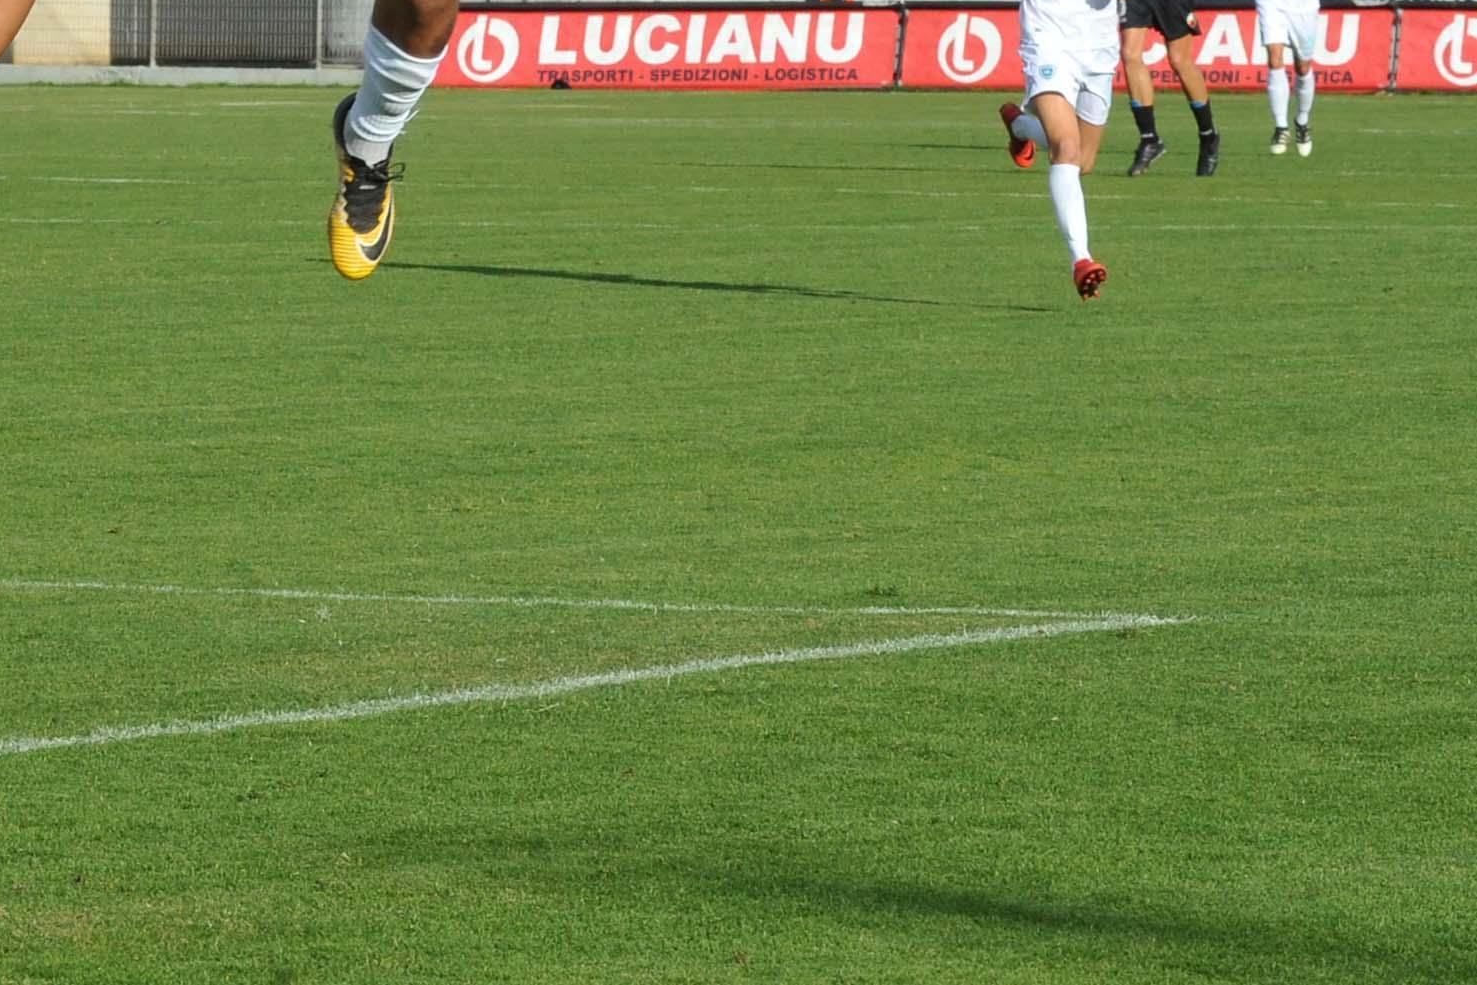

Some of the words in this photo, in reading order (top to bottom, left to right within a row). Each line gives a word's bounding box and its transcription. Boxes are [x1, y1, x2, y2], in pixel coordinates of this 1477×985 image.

[537, 12, 865, 65] LUCIANU
[538, 69, 634, 84] TRASPORTI
[649, 67, 749, 83] SPEDIZIONI
[764, 66, 859, 82] LOGISTICA
